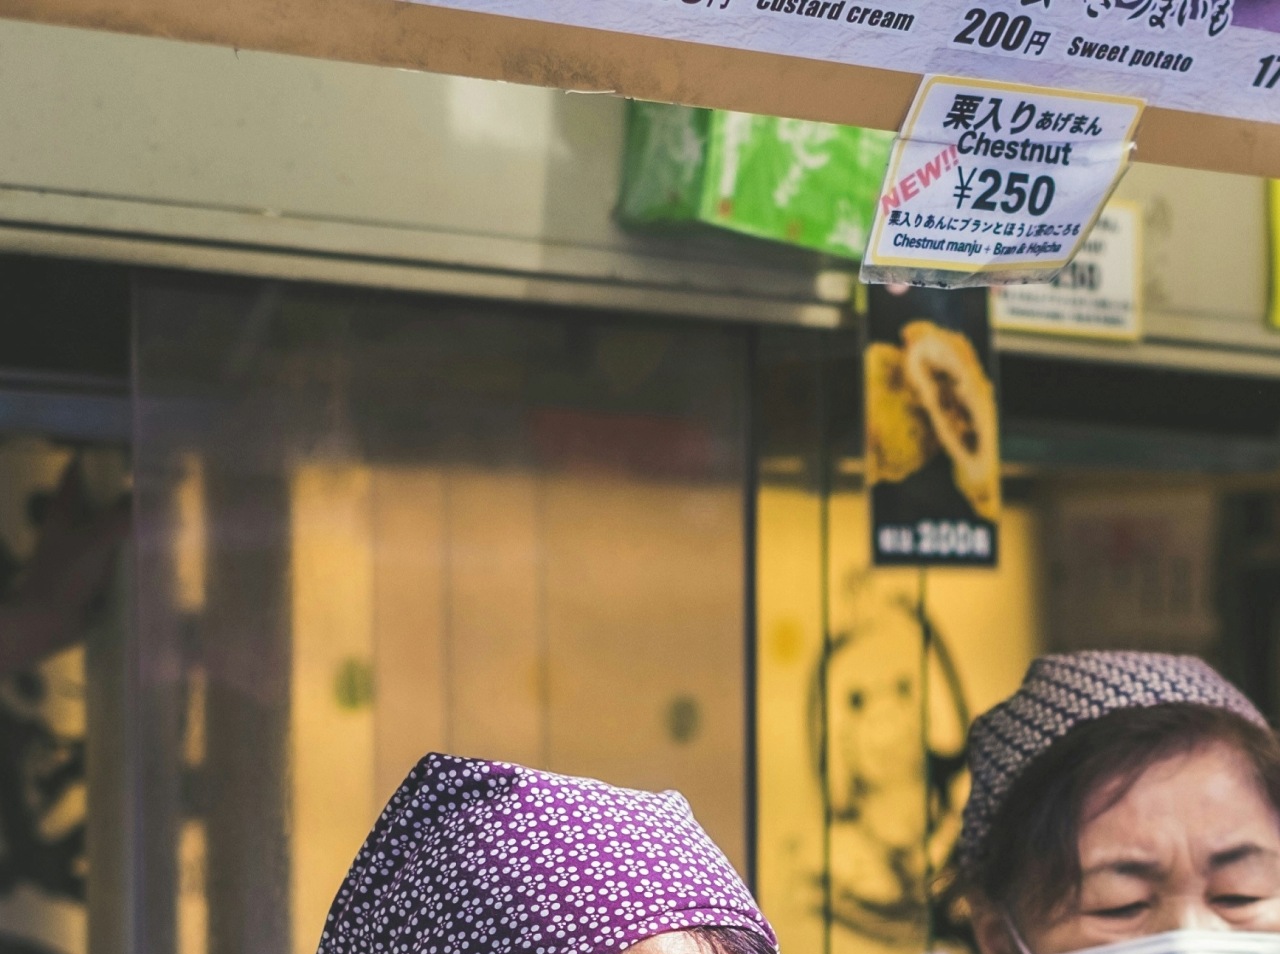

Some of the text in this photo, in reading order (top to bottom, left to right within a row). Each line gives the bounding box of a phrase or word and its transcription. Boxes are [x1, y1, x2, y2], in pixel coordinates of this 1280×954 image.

[846, 5, 915, 32] cream
[953, 7, 1051, 55] 200円
[1067, 36, 1194, 73] Sweet potato
[957, 130, 1073, 166] Chestnut
[880, 143, 960, 216] NEW!!
[953, 165, 1056, 217] ¥250
[893, 232, 946, 252] Chestnut
[945, 239, 983, 257] manju
[993, 242, 1016, 256] Bran
